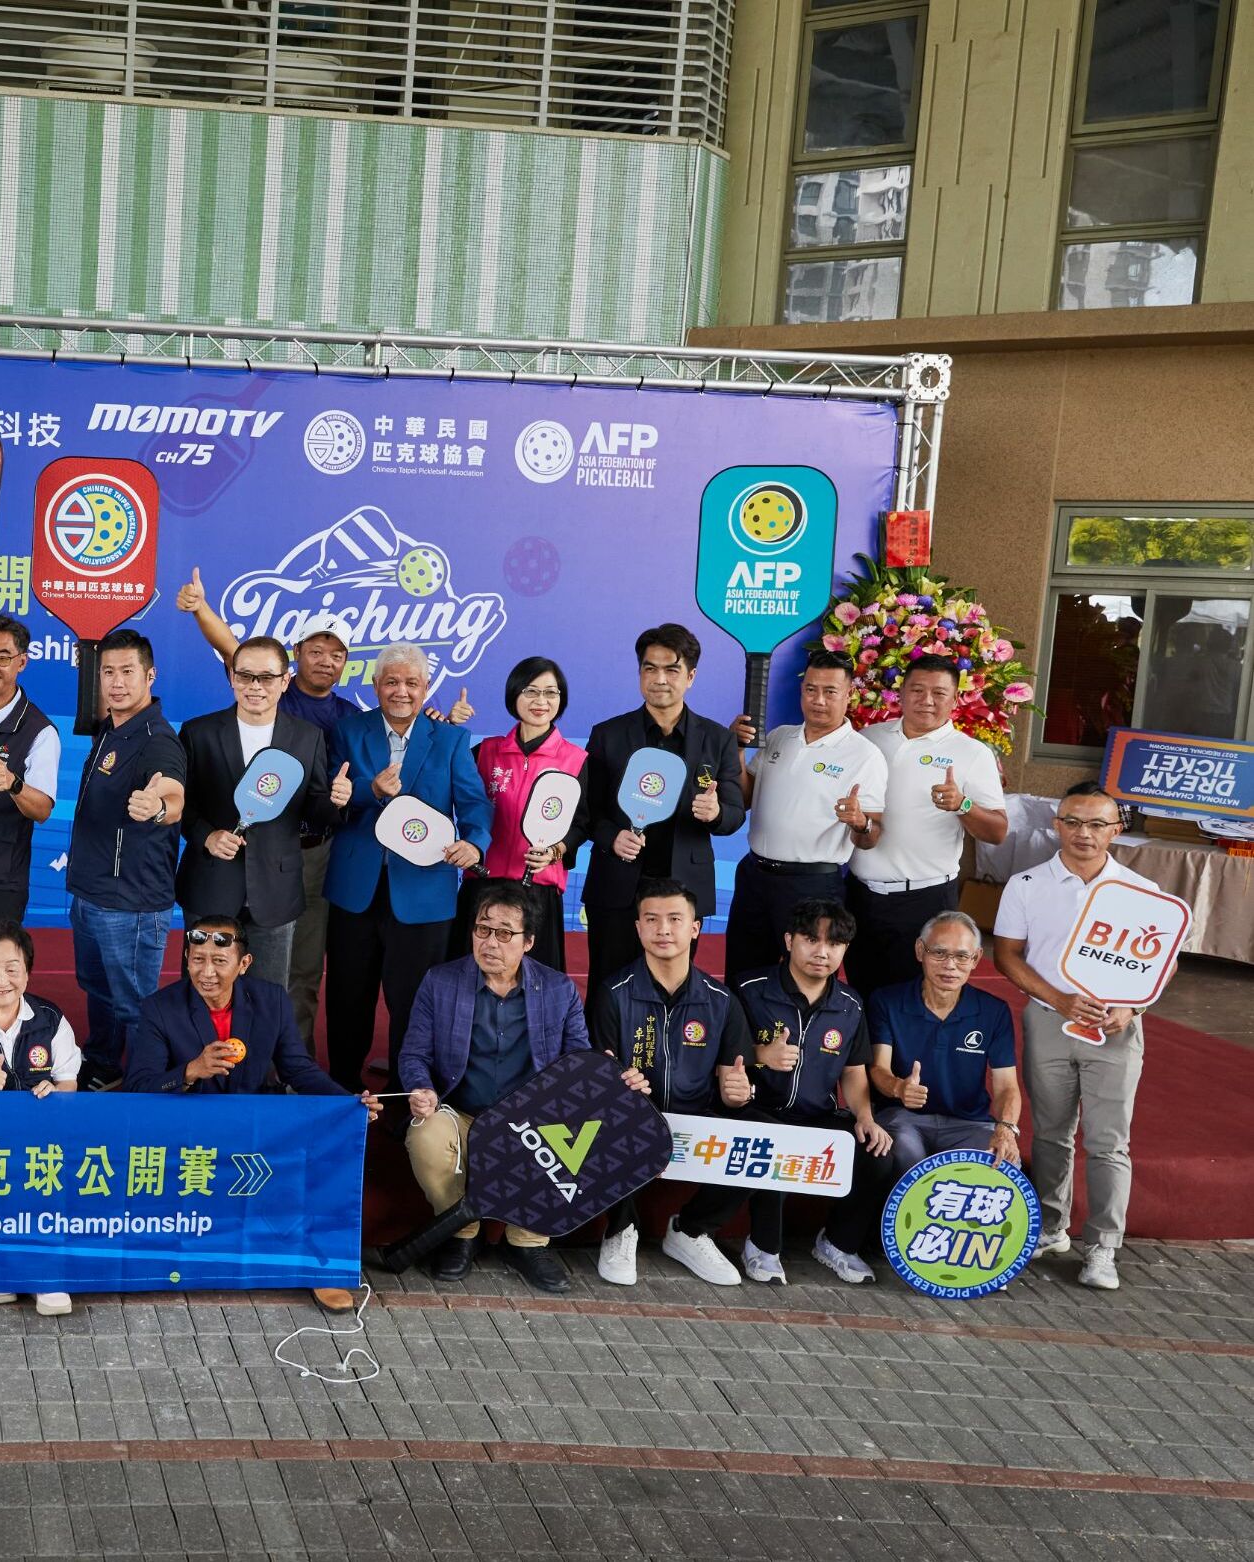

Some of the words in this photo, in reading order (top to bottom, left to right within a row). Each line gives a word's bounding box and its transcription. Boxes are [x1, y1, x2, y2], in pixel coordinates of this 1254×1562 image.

[374, 415, 488, 440] 中華民國
[579, 422, 659, 456] AFP
[372, 441, 486, 466] 匹克球協會
[578, 456, 597, 467] ASIA
[598, 456, 644, 469] FEDERATION
[646, 458, 657, 470] OF
[372, 466, 397, 474] Chinese
[398, 467, 417, 475] Taipei
[419, 467, 447, 475] Pickleball
[448, 469, 484, 477] Association
[576, 468, 655, 489] PICKLEBALL
[82, 485, 112, 495] CHINESE
[113, 491, 131, 511] TAIPEI
[121, 510, 137, 551] PICKLEBALL
[78, 549, 124, 565] ASSOCIATION
[727, 561, 802, 588] AFP
[42, 580, 145, 594] 中華民國匹克球協會
[726, 589, 743, 599] ASIA
[745, 589, 789, 599] FEDERATION
[791, 590, 801, 600] OF
[725, 599, 799, 615] PICKLEBALL
[1149, 743, 1188, 753] SHOWDOWN
[1190, 748, 1221, 757] REGIONAL
[826, 764, 844, 775] AFP
[934, 756, 953, 765] AFP
[1143, 753, 1236, 780] TICKET
[1130, 787, 1194, 799] CHAMPIONSHIP
[1140, 770, 1236, 796] DREAM
[1196, 795, 1240, 806] NATIONAL
[1084, 921, 1163, 960] BIO
[1078, 946, 1152, 973] ENERGY
[508, 1120, 579, 1204] JOOLA
[927, 1180, 1013, 1225] 有球
[37, 1210, 213, 1238] Championship
[907, 1225, 1003, 1270] 必IN
